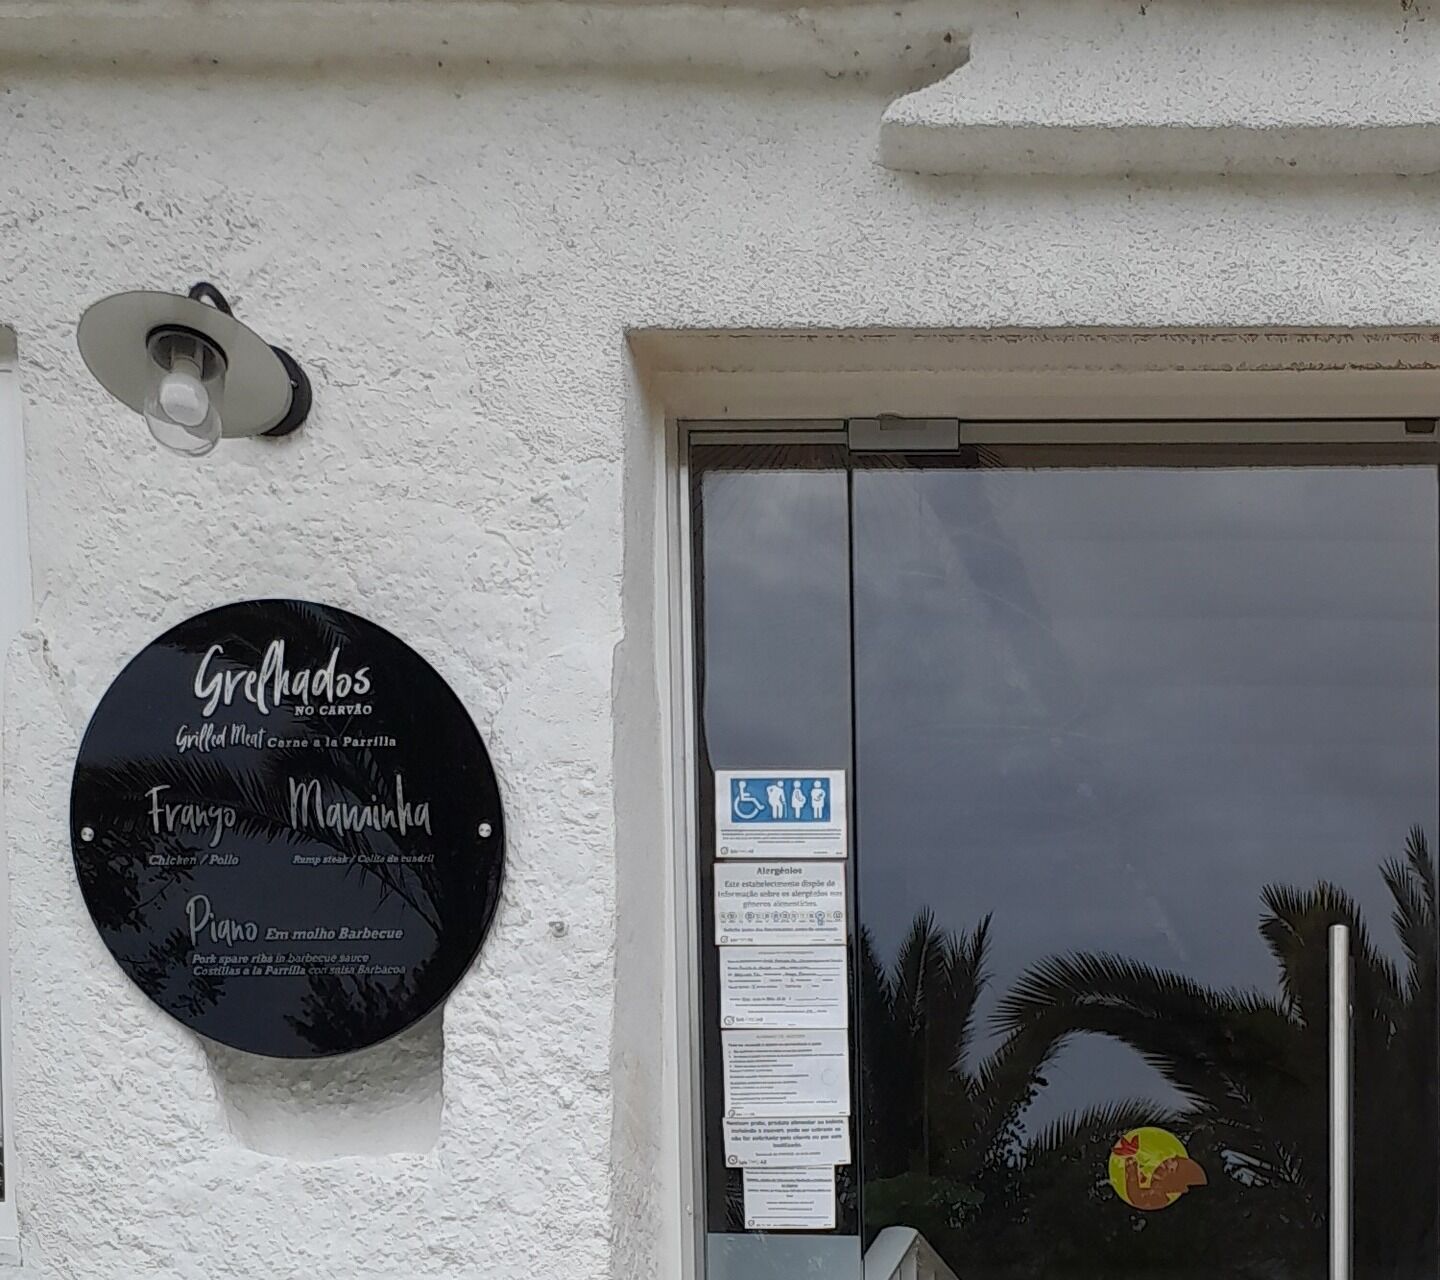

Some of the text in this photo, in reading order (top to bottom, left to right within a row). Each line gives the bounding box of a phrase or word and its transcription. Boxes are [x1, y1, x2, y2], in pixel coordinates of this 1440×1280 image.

[194, 639, 371, 717] Grelhados
[294, 704, 372, 716] NO CARVÃO
[176, 723, 396, 753] Grilled Meat Carne a la Parrilla
[289, 774, 432, 836] Maminha
[145, 784, 236, 848] Frango
[149, 854, 197, 866] Chicken
[209, 854, 239, 865] Pollo
[293, 854, 321, 866] Rump
[387, 854, 399, 864] de
[186, 895, 403, 947] Piano Em molho Barbecue
[192, 953, 369, 966] Pork spare ribs in barbecue sauce
[193, 965, 240, 976] Costillas
[243, 967, 250, 975] a
[252, 966, 262, 975] la
[264, 965, 306, 976] Parrilla
